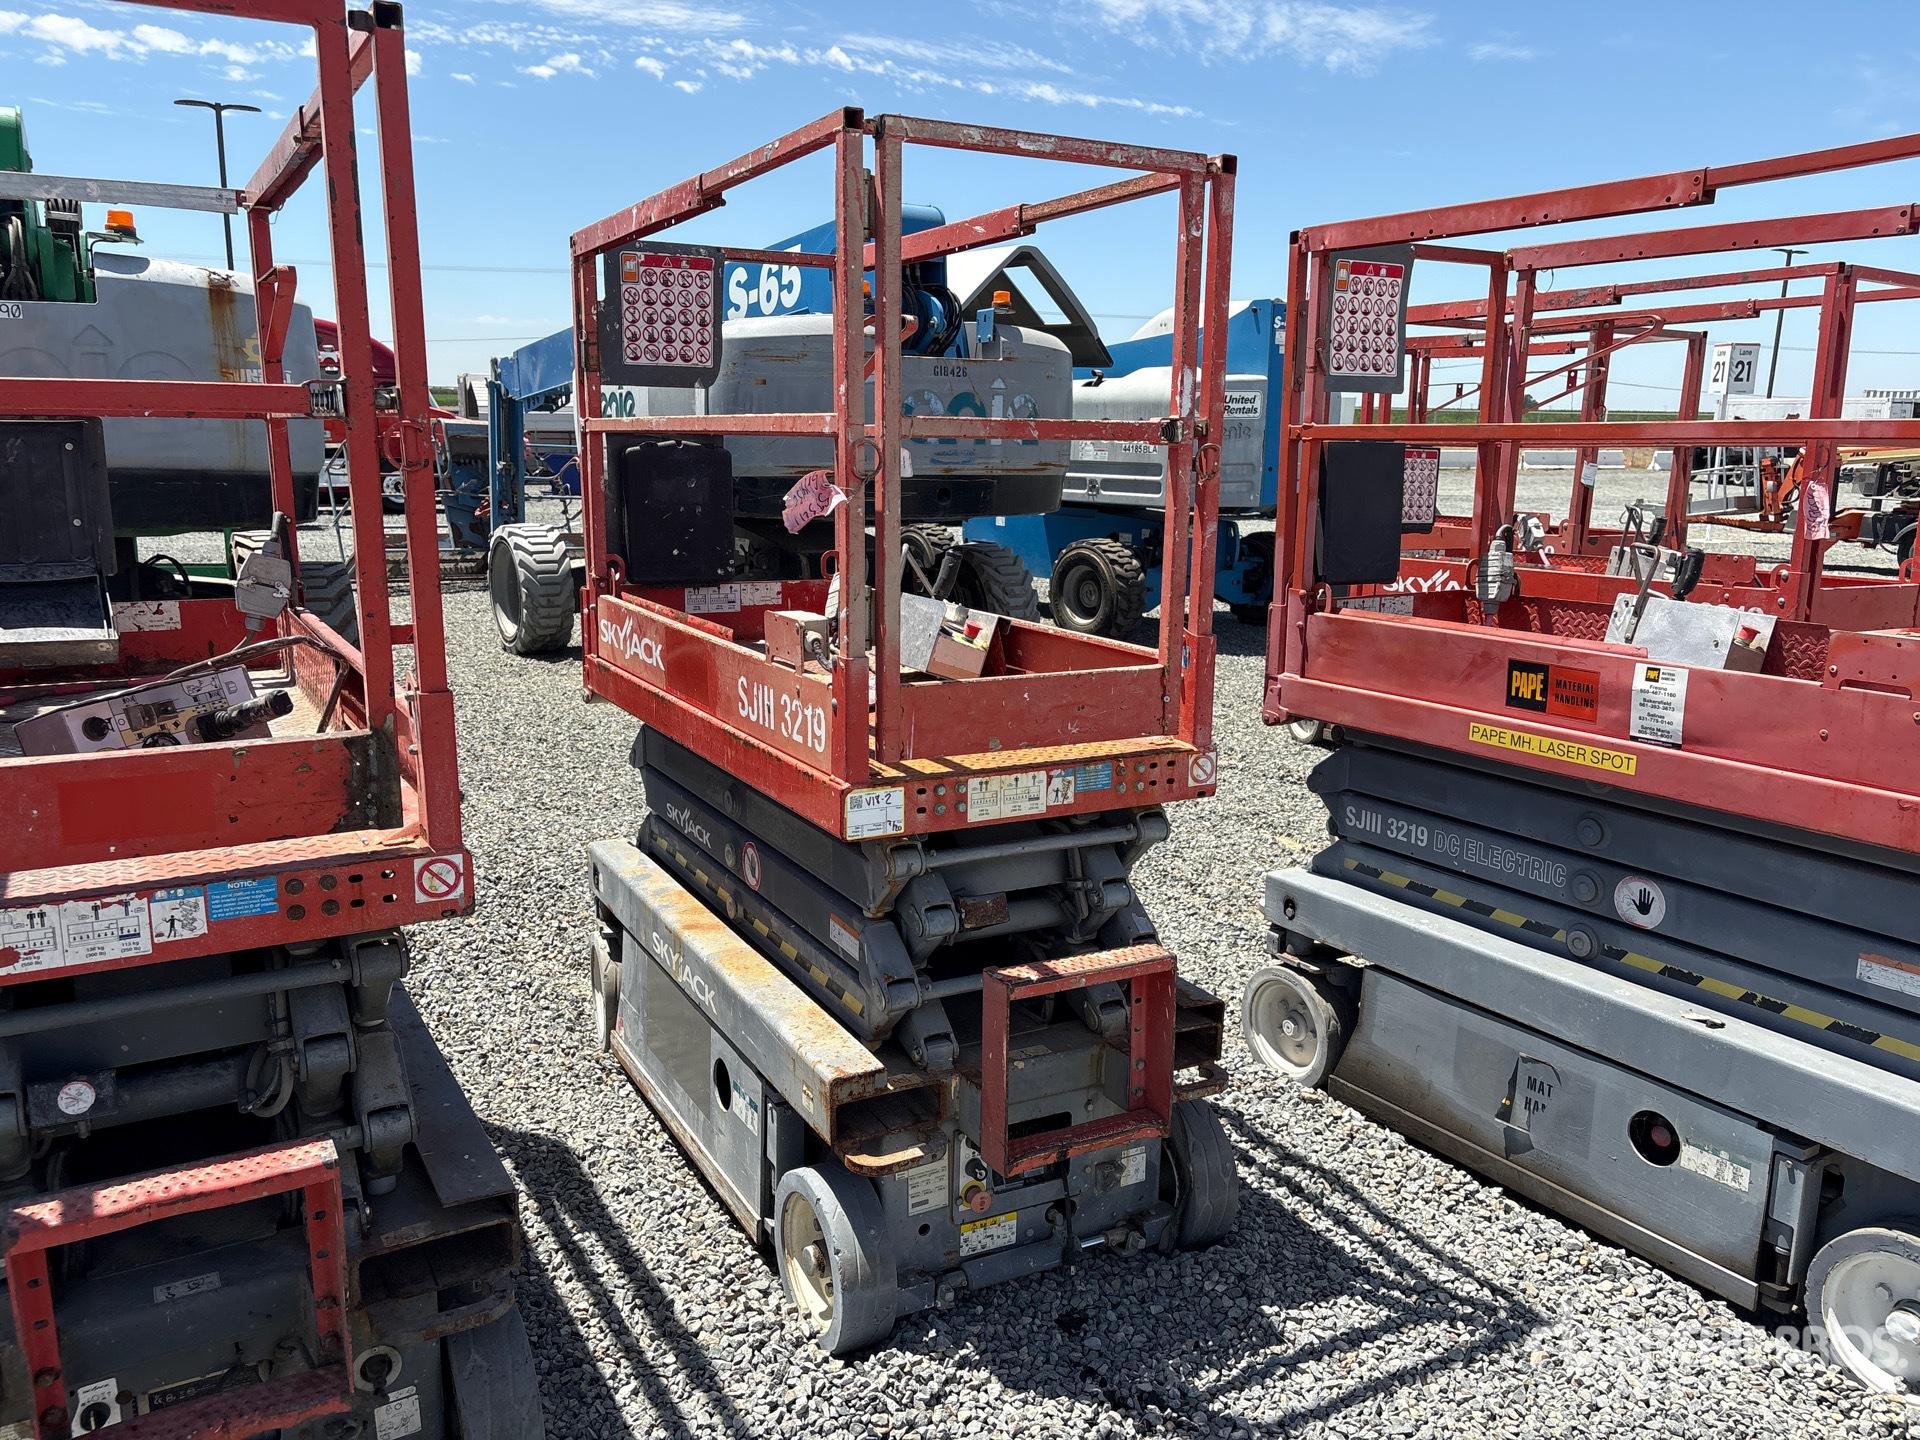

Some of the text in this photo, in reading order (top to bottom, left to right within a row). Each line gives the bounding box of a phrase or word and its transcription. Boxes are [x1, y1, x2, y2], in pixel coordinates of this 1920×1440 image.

[727, 244, 801, 319] S-65
[1712, 360, 1726, 382] 21
[1734, 360, 1752, 382] 21
[1224, 395, 1256, 404] United
[1224, 406, 1258, 415] Rentals
[1122, 445, 1158, 454] 44185BLA
[600, 615, 665, 671] SKYJACK
[1556, 679, 1594, 694] MATERIAL
[1554, 693, 1594, 708] HANDLING
[1643, 698, 1672, 706] Bakersfield
[781, 694, 826, 752] 3219
[1472, 726, 1634, 771] PAPE MH. LASER SPOT
[666, 802, 712, 849] SKYJACK
[1345, 806, 1567, 888] SJIII 3219 DC ELECTRIC
[228, 880, 258, 890] NOTICE
[652, 931, 718, 1015] SKYJACK
